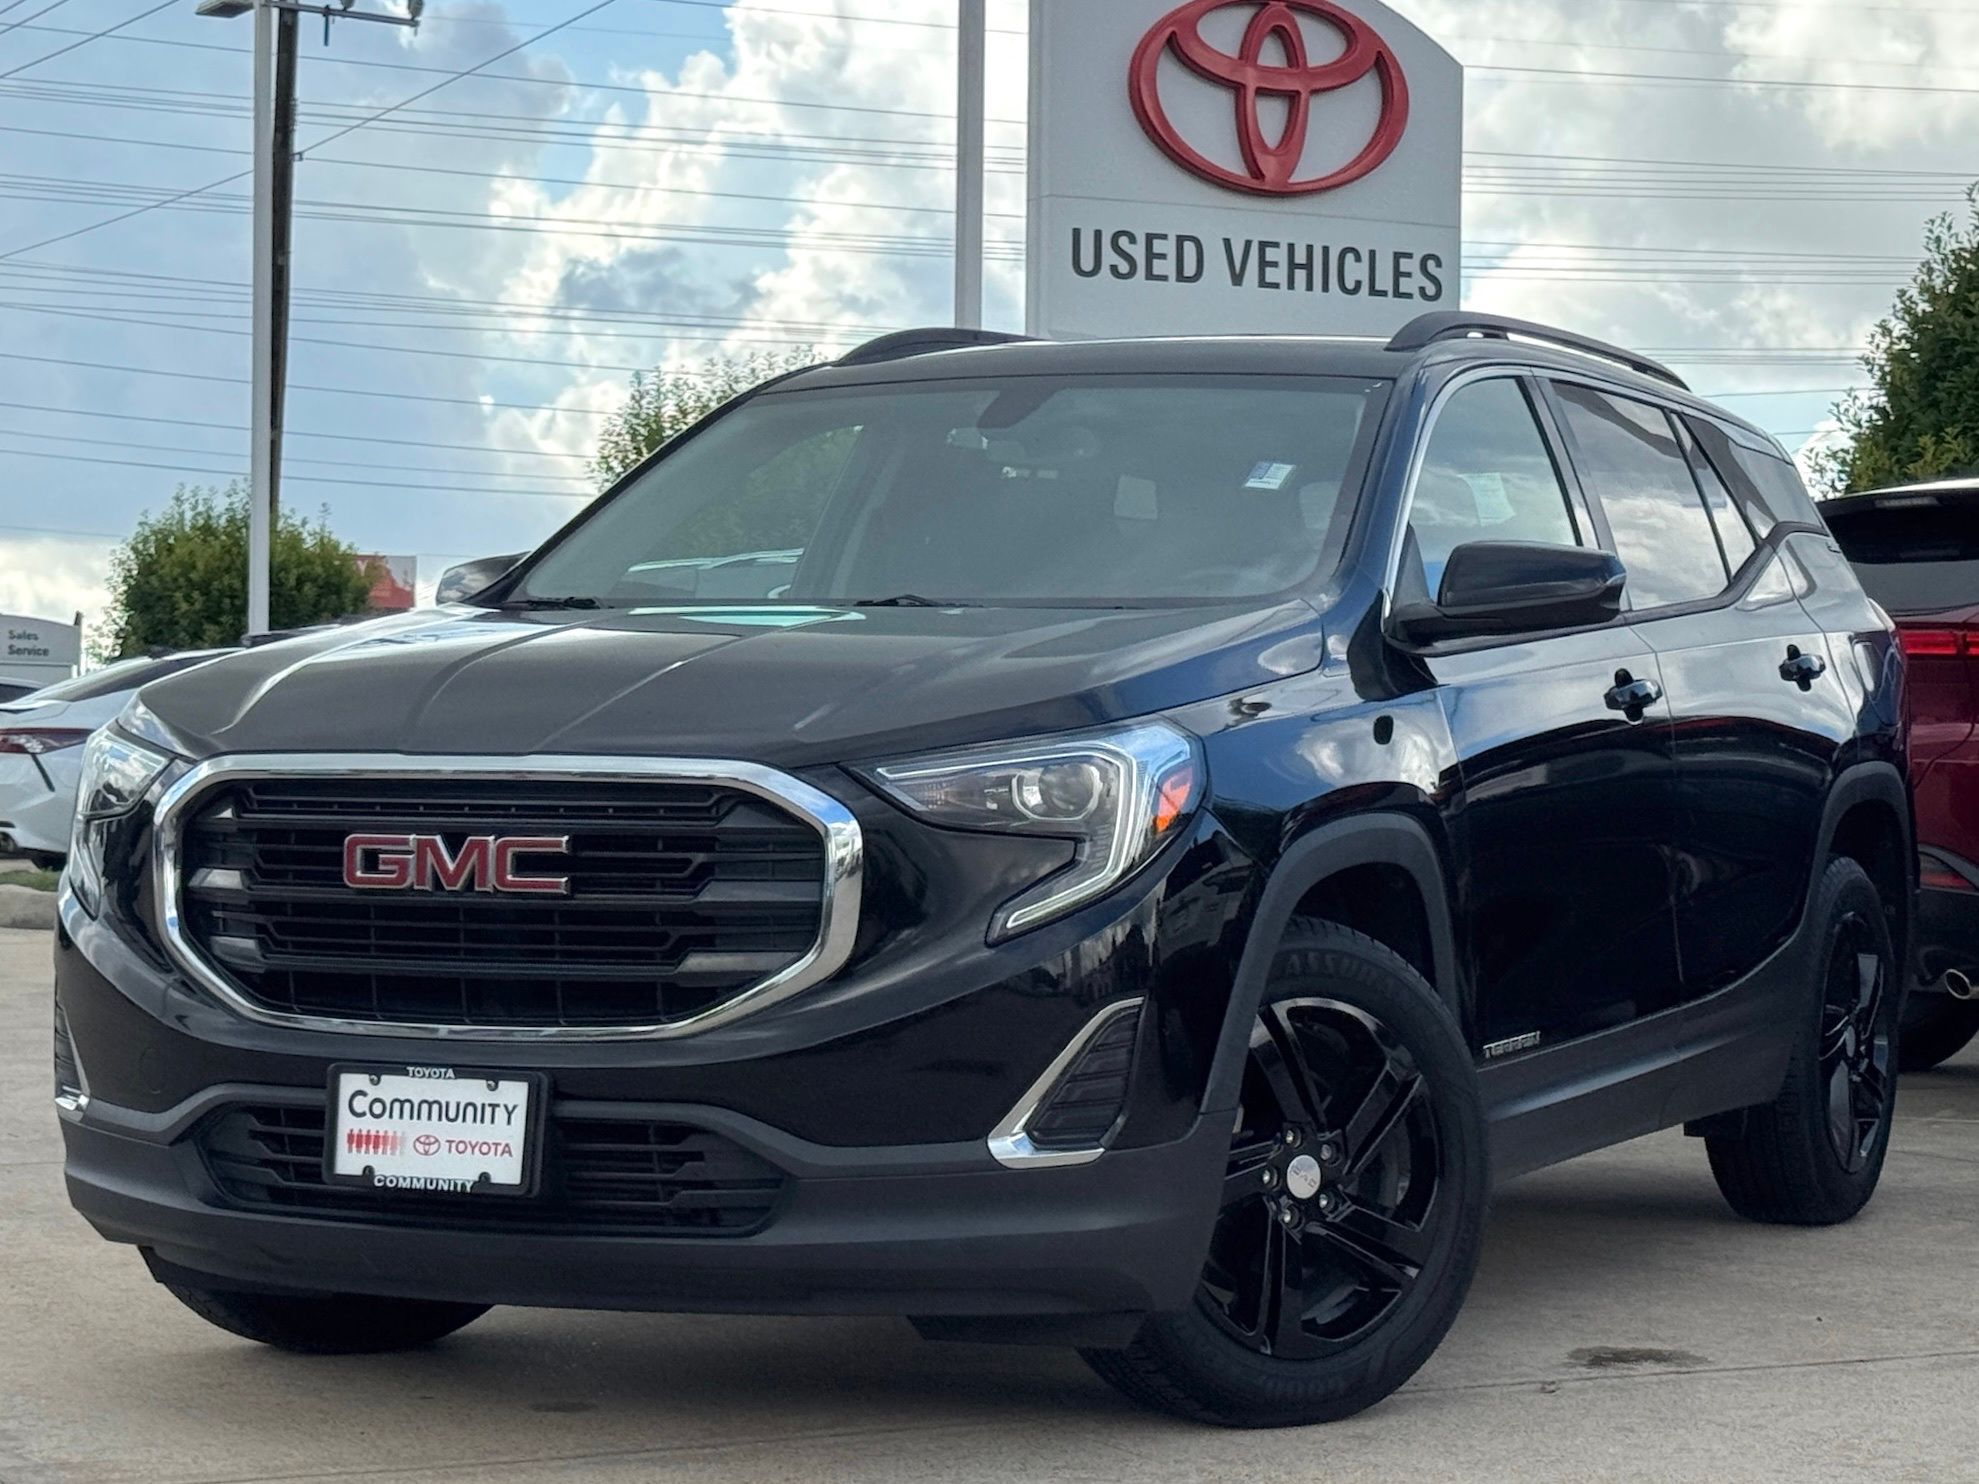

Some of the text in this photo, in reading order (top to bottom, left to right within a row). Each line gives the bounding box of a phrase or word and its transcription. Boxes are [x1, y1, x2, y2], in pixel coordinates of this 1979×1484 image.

[1071, 227, 1443, 302] USED VEHICLES
[8, 629, 39, 641] Sales
[8, 644, 50, 657] Service
[343, 833, 570, 895] GMC
[407, 1066, 455, 1079] TOYOTA
[445, 1139, 513, 1158] TOYOTA
[373, 1174, 474, 1193] COMMUNITY
